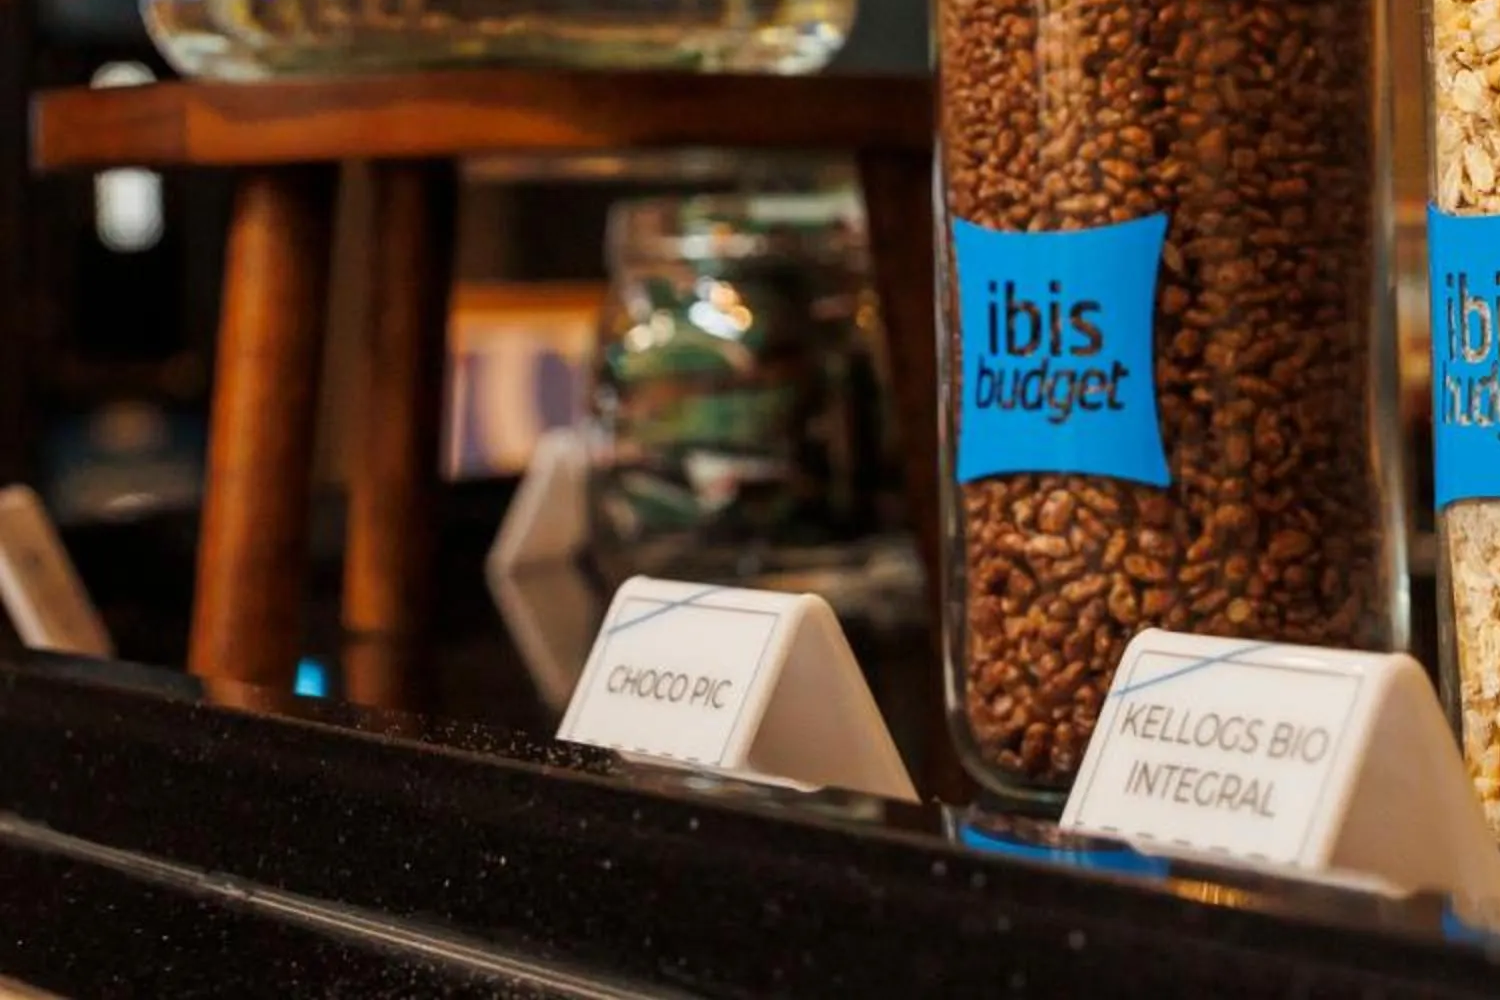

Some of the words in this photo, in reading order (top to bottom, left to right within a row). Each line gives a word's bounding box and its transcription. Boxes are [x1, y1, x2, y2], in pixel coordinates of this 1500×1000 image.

[988, 280, 1103, 357] ibis
[975, 355, 1130, 425] budget
[606, 664, 689, 703] CHOCO
[689, 675, 733, 709] PIC
[1120, 702, 1265, 756] KELLOGS
[1266, 721, 1331, 764] BIO
[1124, 759, 1276, 818] INTEGRAL
